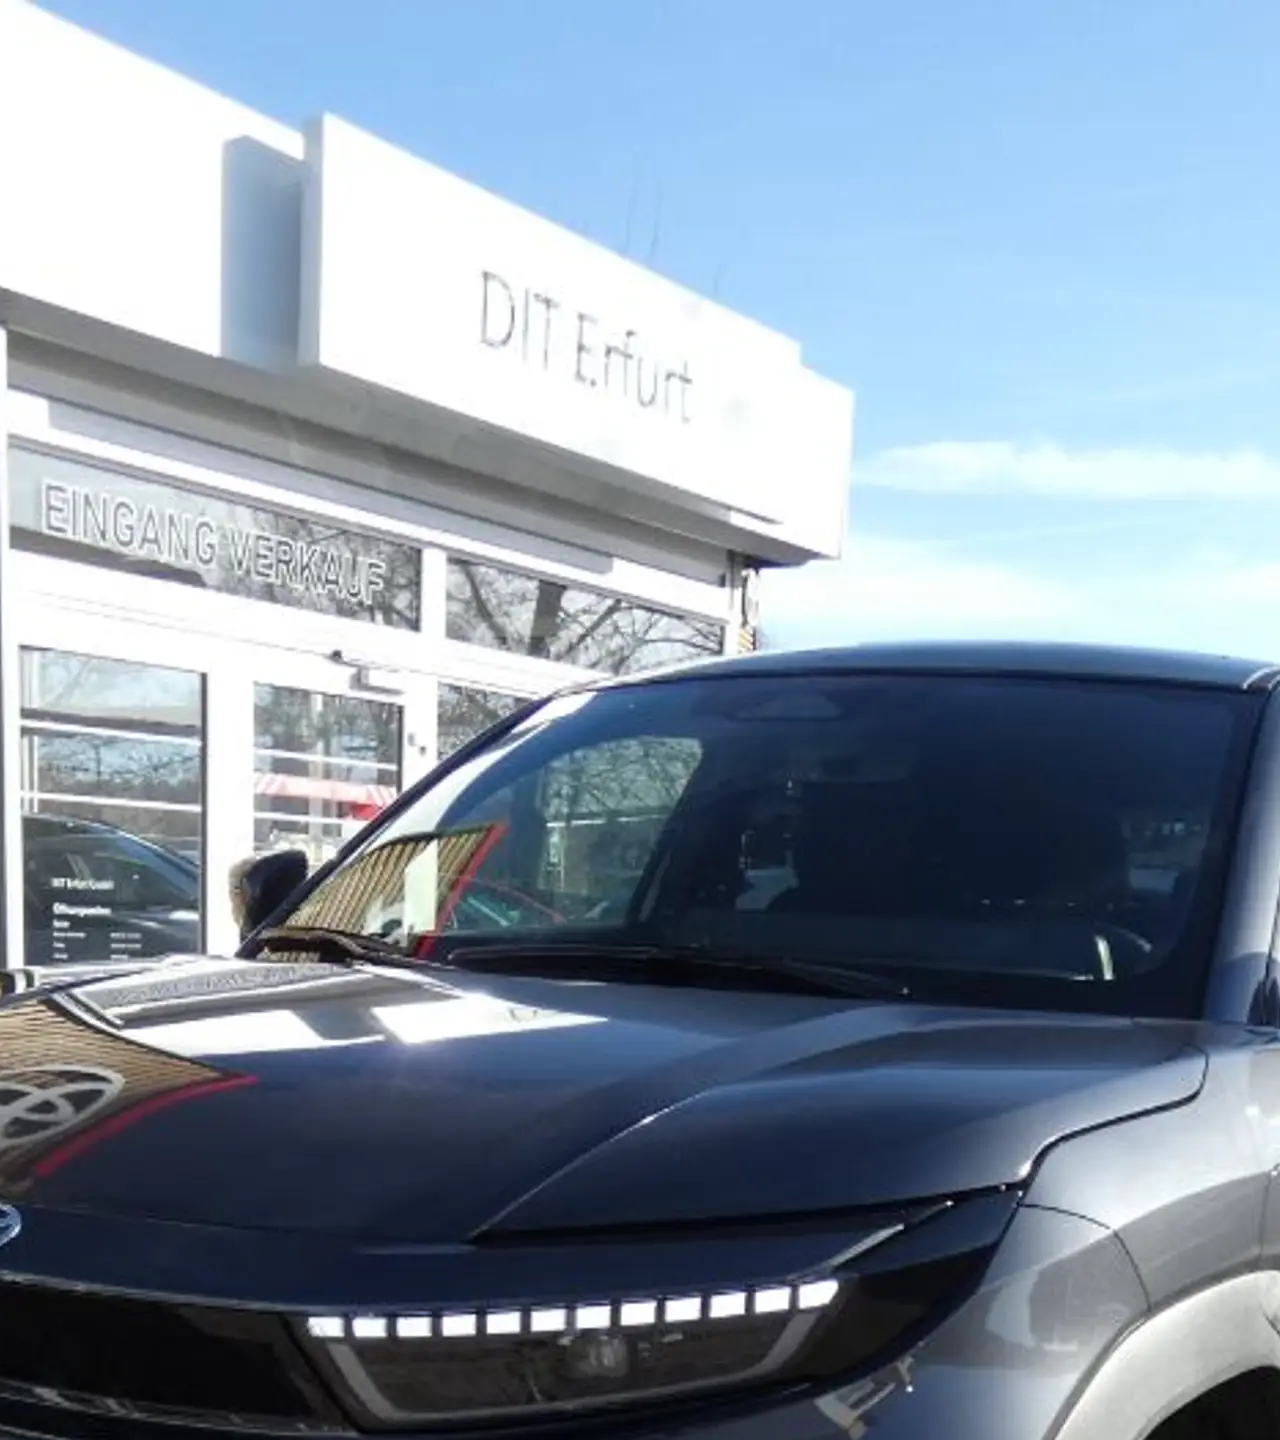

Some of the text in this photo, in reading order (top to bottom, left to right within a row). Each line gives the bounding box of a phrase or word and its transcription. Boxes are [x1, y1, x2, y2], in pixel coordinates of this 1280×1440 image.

[481, 270, 693, 425] DIT Erfurt
[41, 479, 386, 604] EINGANG VERKAUF
